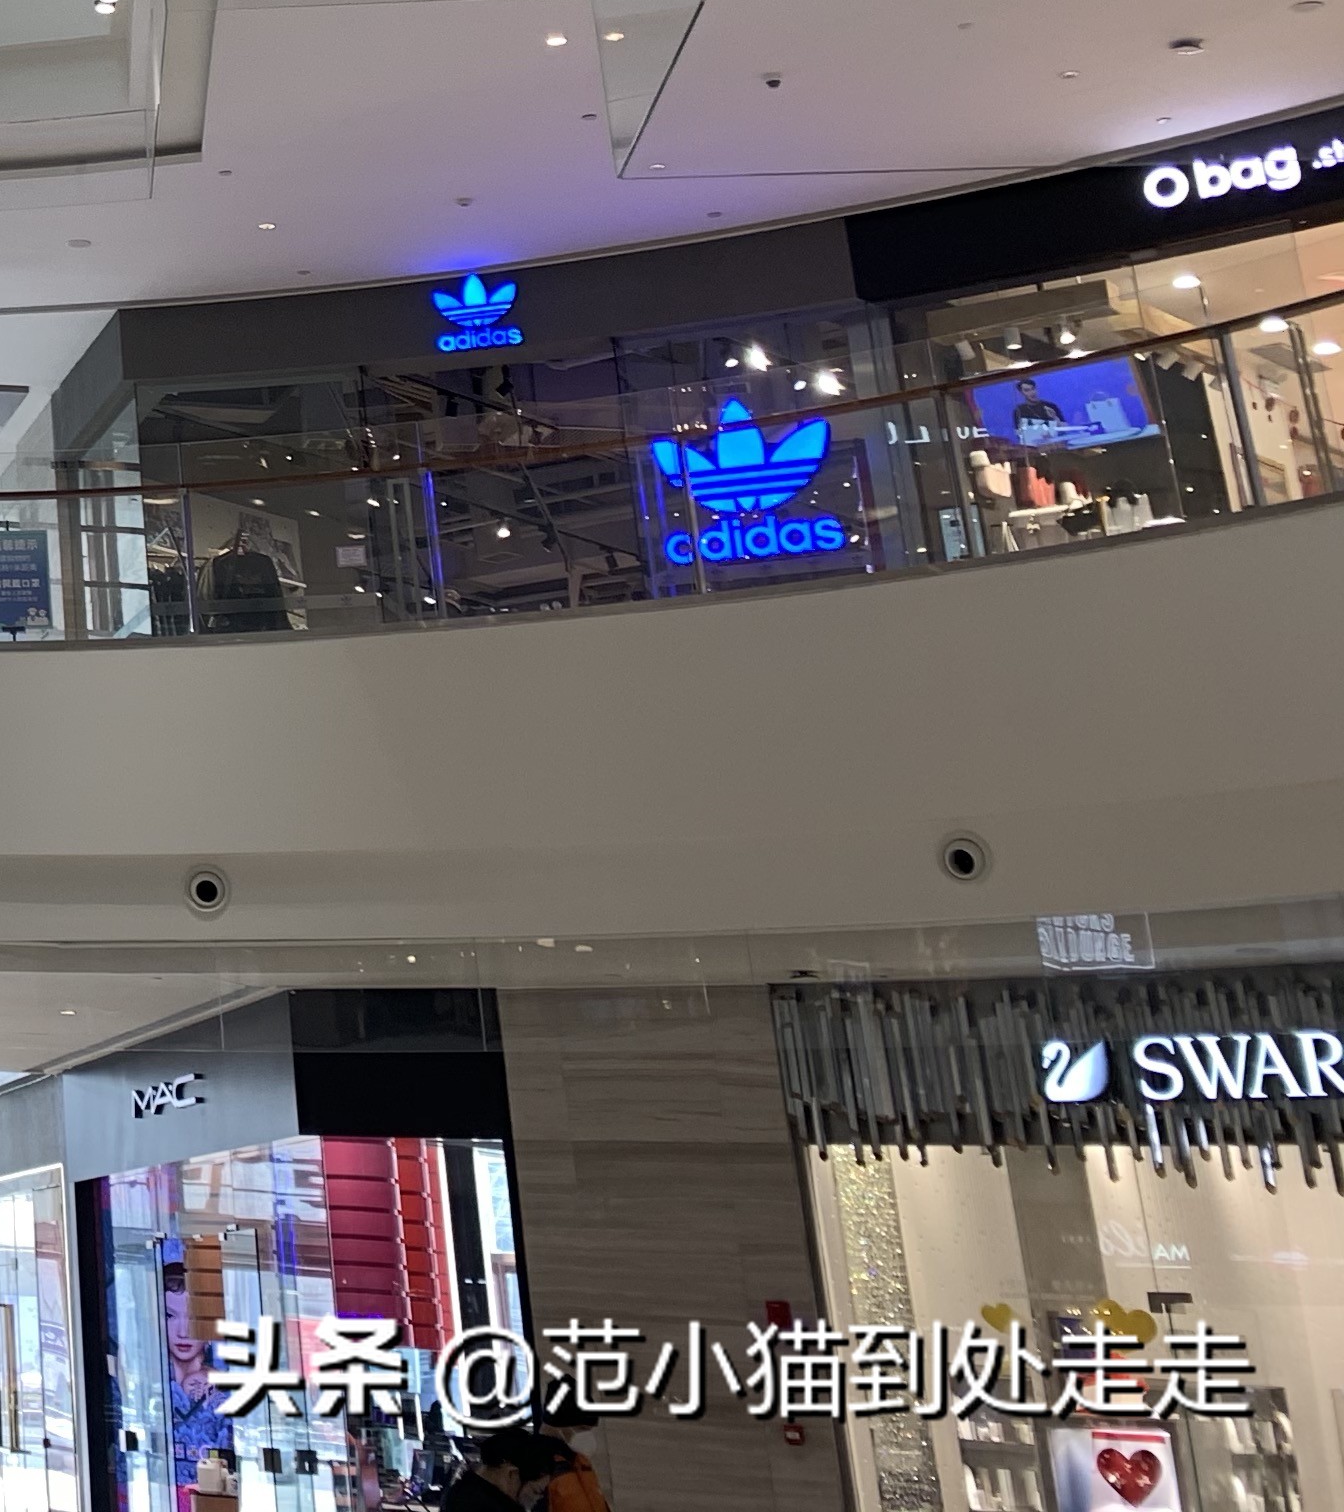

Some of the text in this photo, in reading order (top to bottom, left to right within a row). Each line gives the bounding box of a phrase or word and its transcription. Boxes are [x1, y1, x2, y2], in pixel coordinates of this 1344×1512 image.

[1143, 166, 1190, 208] O
[1192, 145, 1302, 200] bag
[438, 328, 524, 352] adidas
[665, 515, 846, 565] adidas
